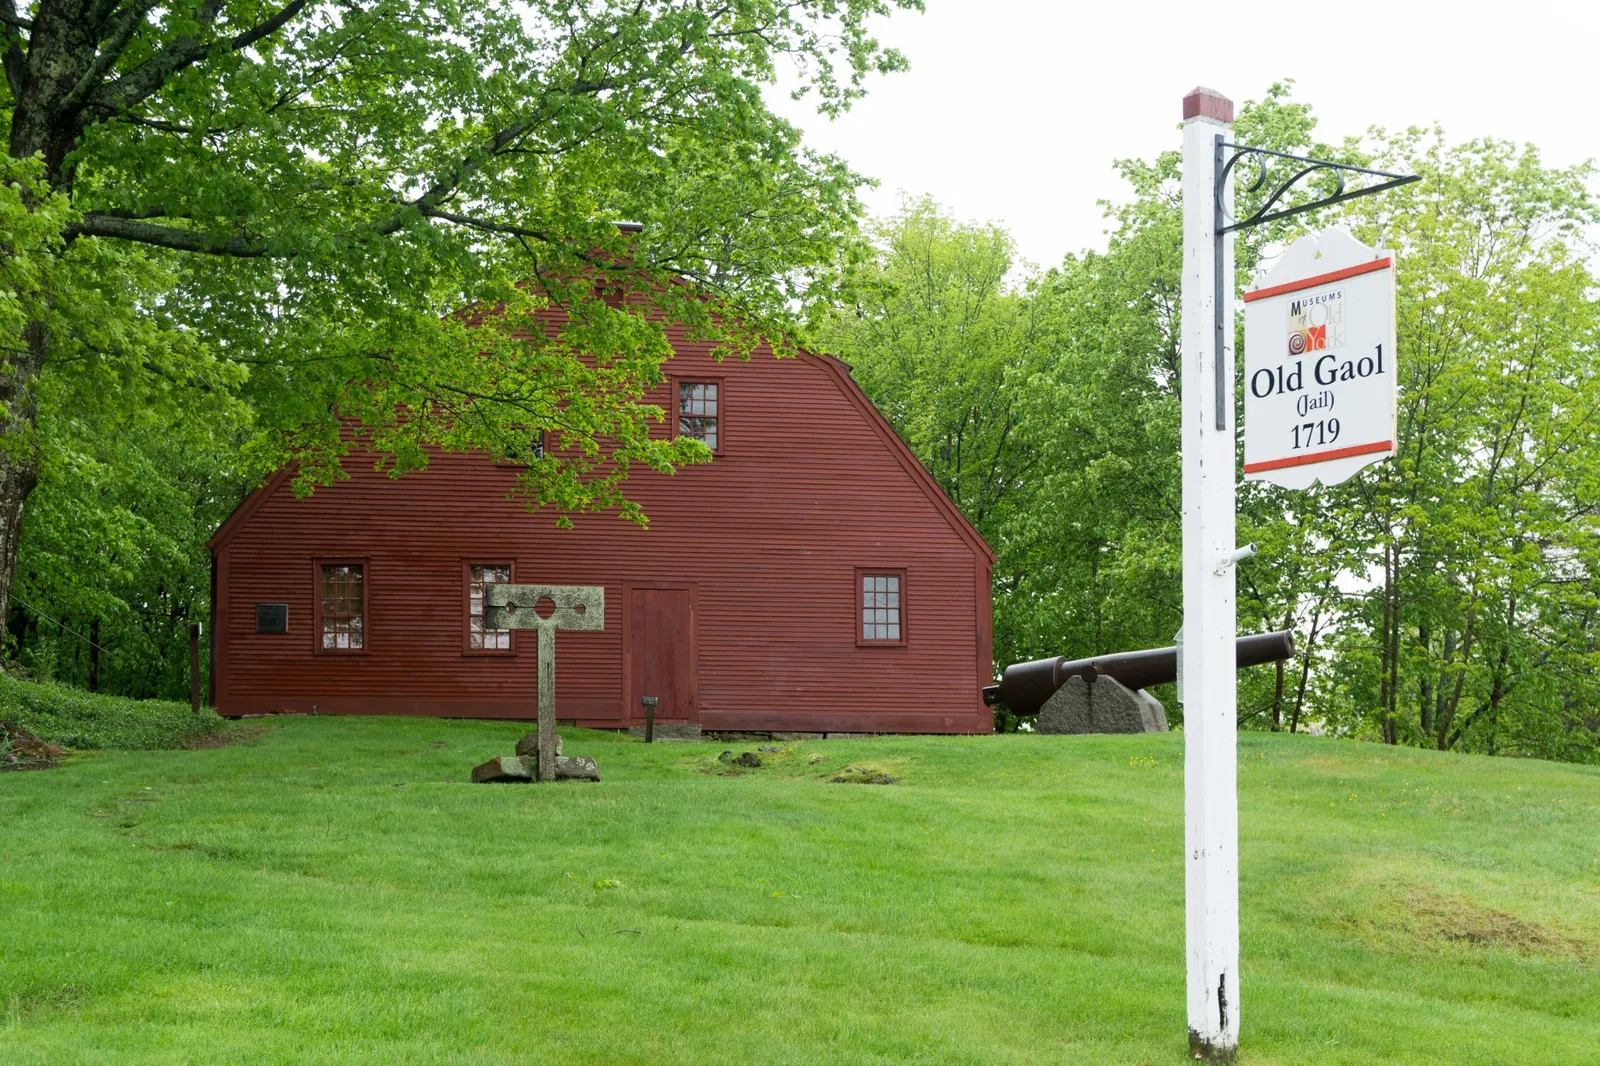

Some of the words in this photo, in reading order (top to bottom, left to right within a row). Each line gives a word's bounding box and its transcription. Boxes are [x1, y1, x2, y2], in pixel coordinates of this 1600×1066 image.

[1291, 291, 1342, 317] MUSEUMS
[1298, 311, 1307, 328] of
[1309, 301, 1342, 327] Old
[1306, 326, 1344, 351] York
[1251, 361, 1304, 398] Old
[1314, 343, 1385, 386] Gaol
[1296, 390, 1335, 417] (Jail)
[1291, 418, 1340, 449] 1719
